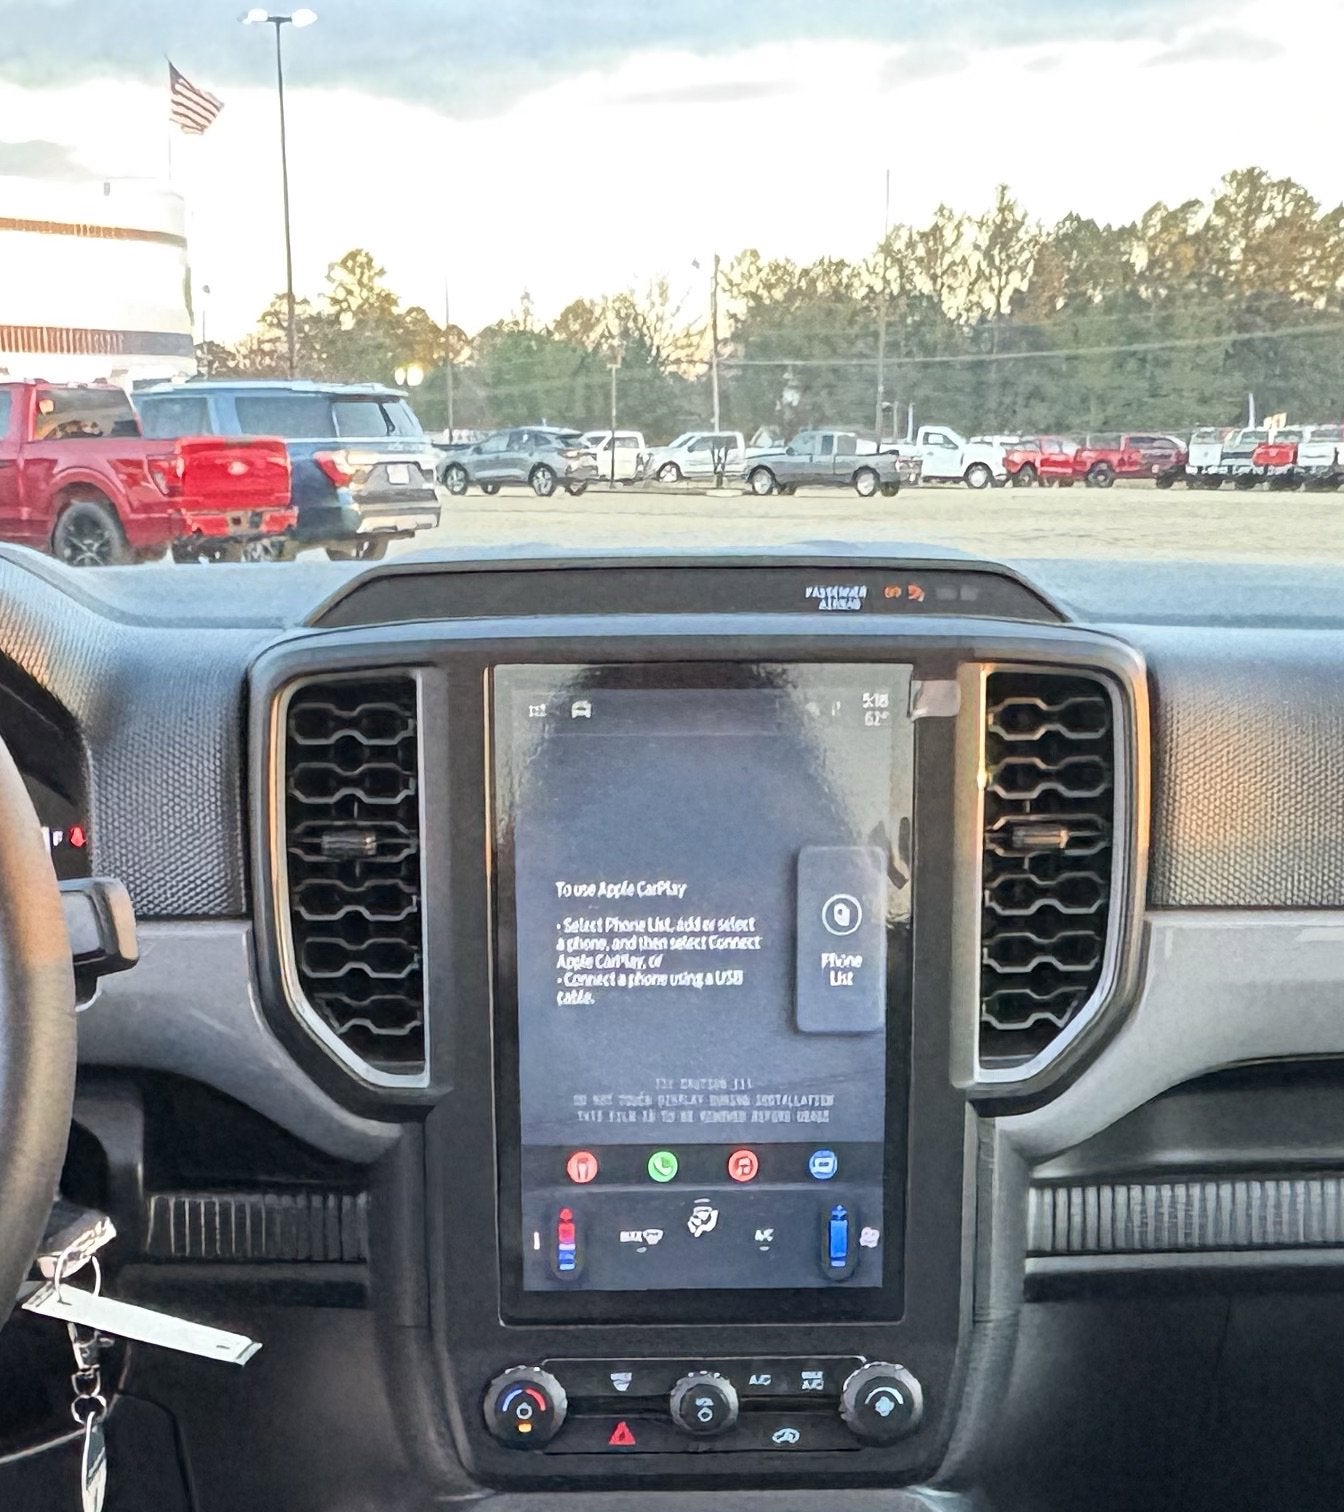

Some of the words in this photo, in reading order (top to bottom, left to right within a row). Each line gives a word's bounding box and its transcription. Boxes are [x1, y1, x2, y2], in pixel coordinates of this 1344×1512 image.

[555, 880, 571, 898] To
[573, 884, 596, 898] use
[597, 880, 635, 899] Apple
[636, 880, 688, 899] CarPlay
[563, 916, 603, 933] Select
[605, 916, 646, 932] Phone
[717, 916, 756, 932] select
[612, 935, 637, 951] and
[639, 935, 668, 951] then
[670, 936, 707, 951] select
[708, 935, 763, 950] Connect
[556, 954, 594, 970] Apple
[821, 952, 863, 969] Phone
[563, 972, 616, 987] Connect
[628, 972, 668, 989] phone
[669, 971, 704, 989] using
[715, 969, 744, 986] USB
